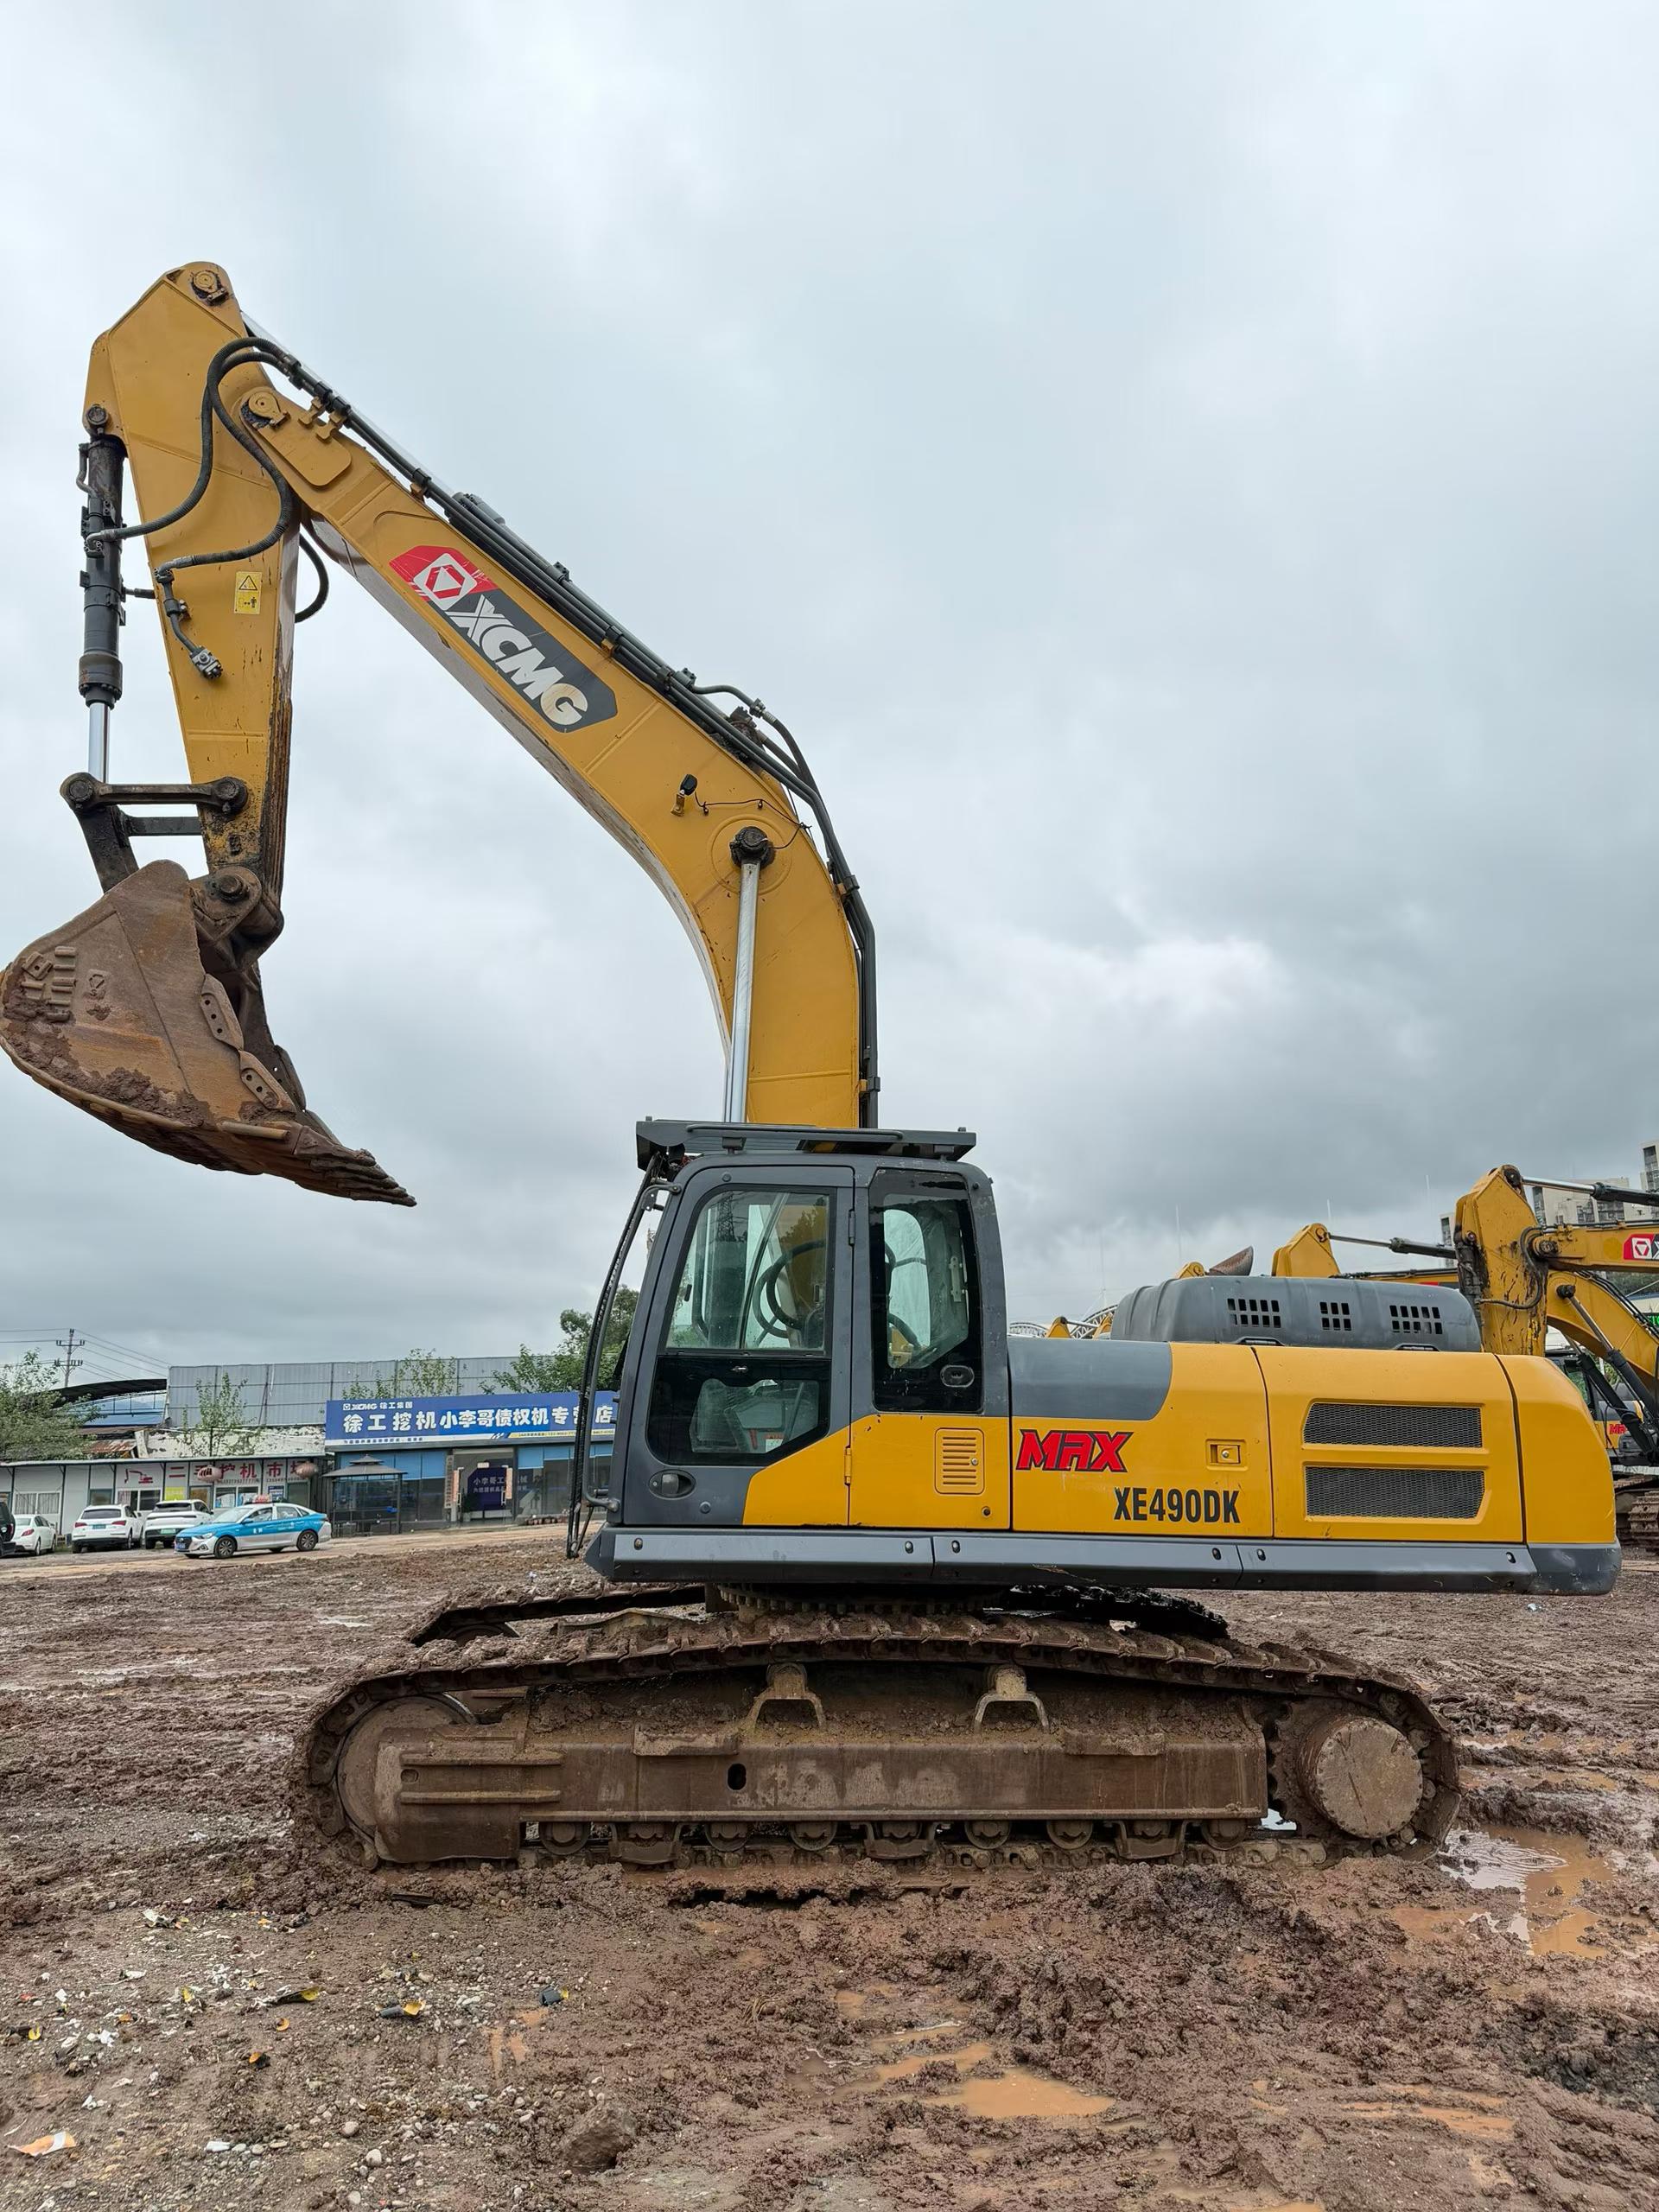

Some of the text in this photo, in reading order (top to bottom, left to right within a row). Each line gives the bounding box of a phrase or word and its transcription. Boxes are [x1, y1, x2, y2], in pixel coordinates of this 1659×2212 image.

[444, 594, 588, 726] XCMG
[1016, 1428, 1135, 1472] MAX
[1114, 1487, 1240, 1523] XE490DK
